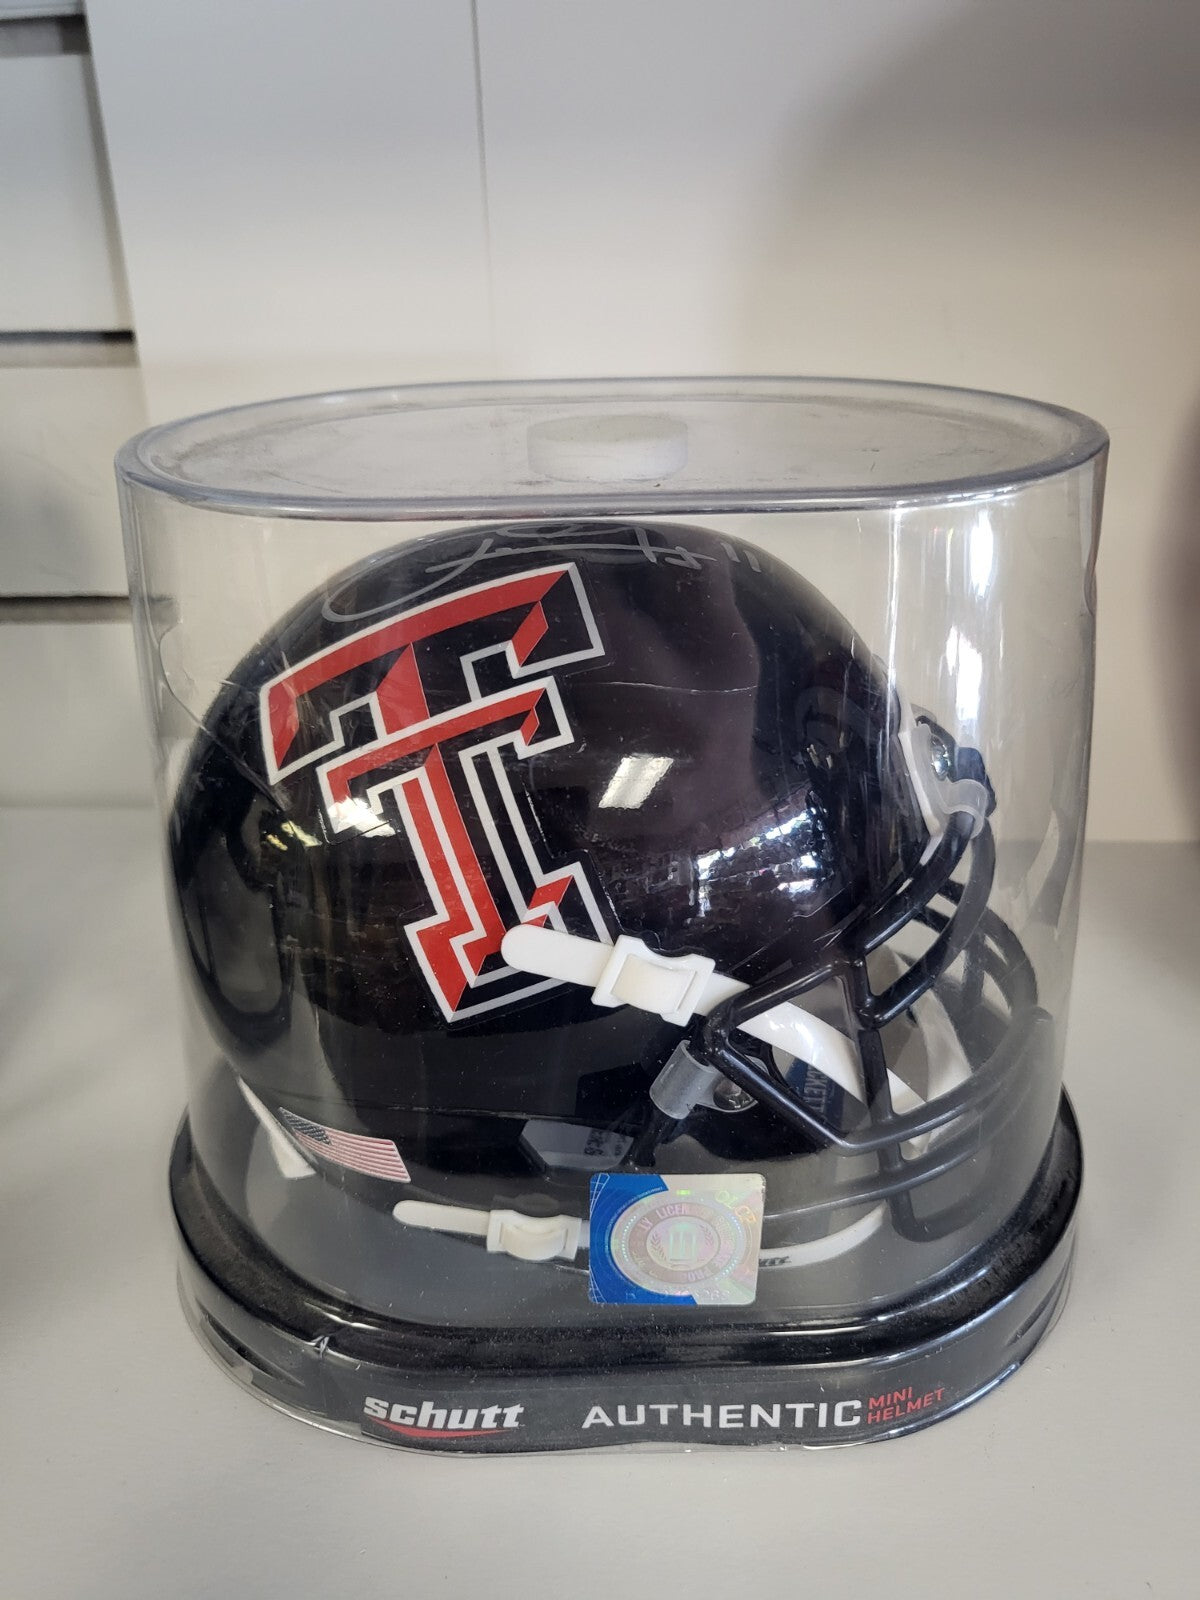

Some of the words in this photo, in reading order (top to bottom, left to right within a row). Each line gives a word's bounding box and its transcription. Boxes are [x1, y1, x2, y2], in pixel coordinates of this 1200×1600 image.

[867, 1387, 946, 1425] HELMET
[868, 1386, 913, 1410] MINI
[581, 1399, 862, 1429] AUTHENTIC
